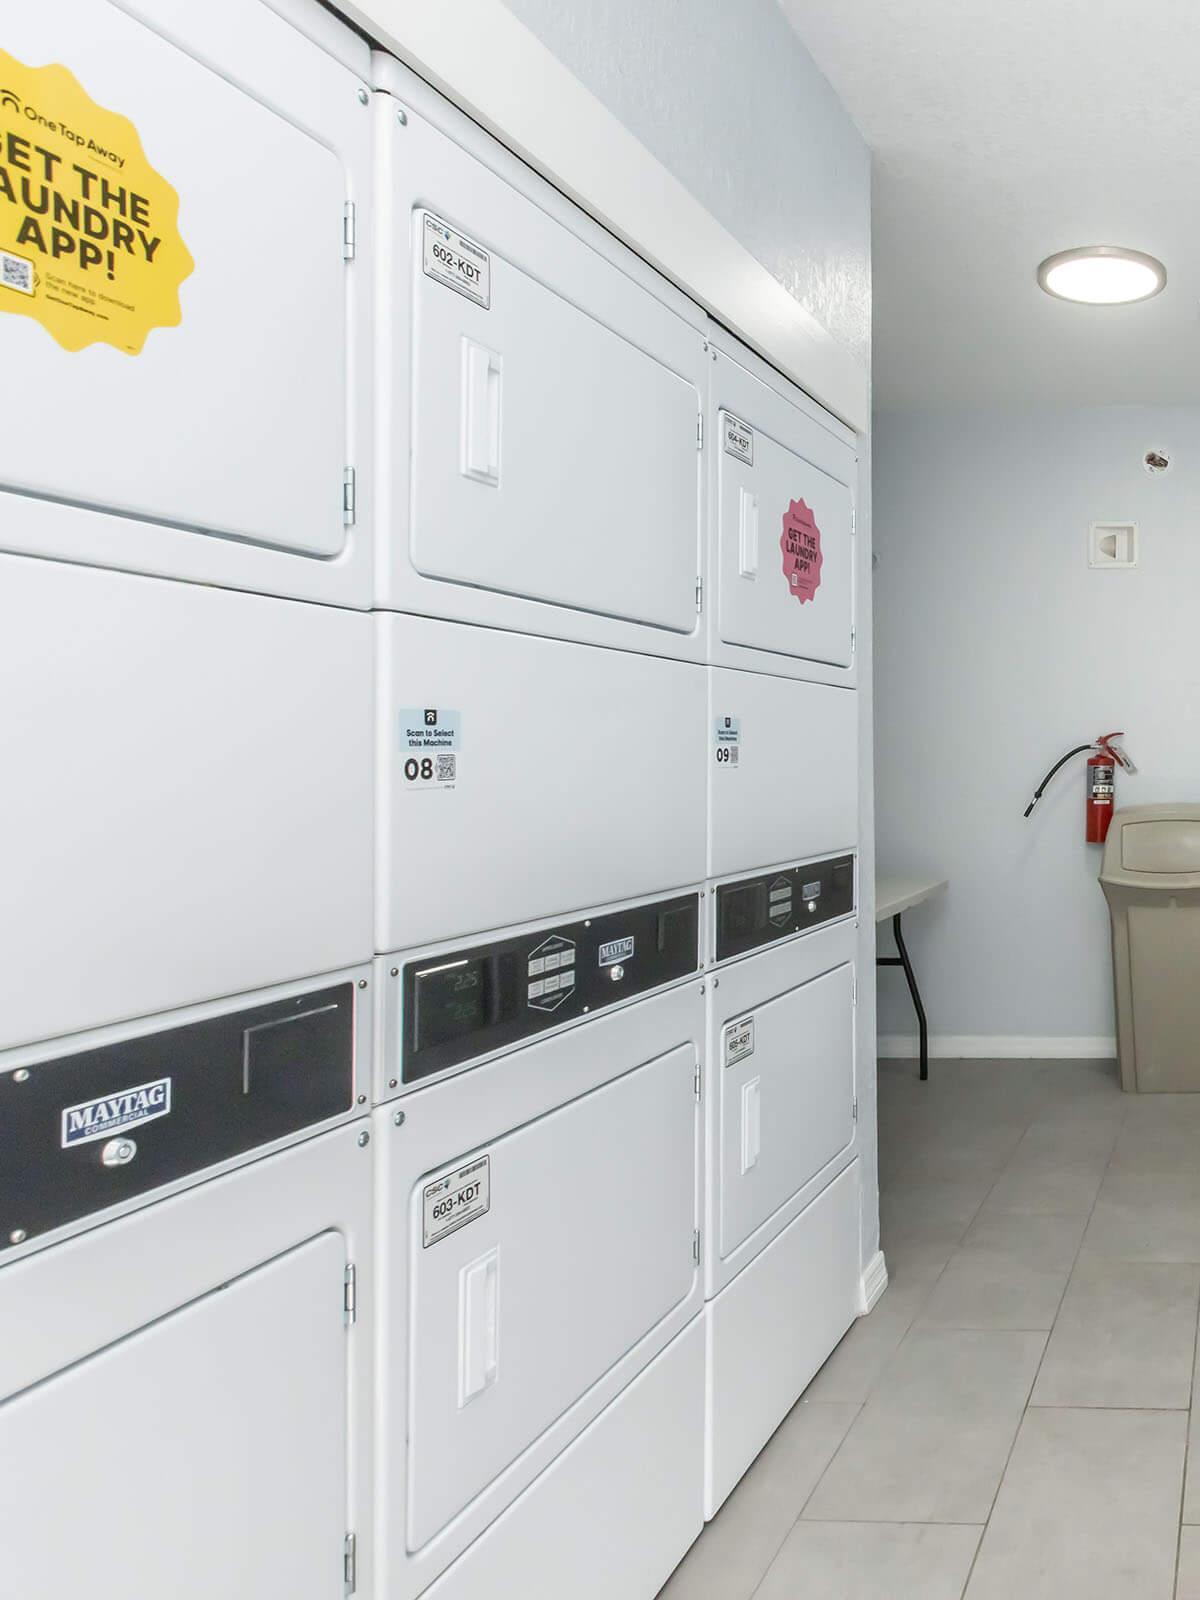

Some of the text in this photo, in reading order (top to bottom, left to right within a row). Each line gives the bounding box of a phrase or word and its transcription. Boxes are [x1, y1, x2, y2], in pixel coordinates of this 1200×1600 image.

[0, 131, 150, 228] ET THE
[16, 214, 116, 281] APP!
[432, 243, 482, 282] 602-KDT
[788, 527, 816, 549] GET THE
[786, 539, 818, 563] LAUNDRY
[406, 729, 454, 737] Scan to Select
[409, 739, 452, 747] this Machine
[717, 747, 729, 762] 09
[404, 757, 433, 781] 08
[600, 939, 633, 958] MAYTAG
[68, 1084, 165, 1133] MAYTAG
[85, 1108, 149, 1136] COMMERCIAL
[432, 1182, 481, 1219] 603-KDT
